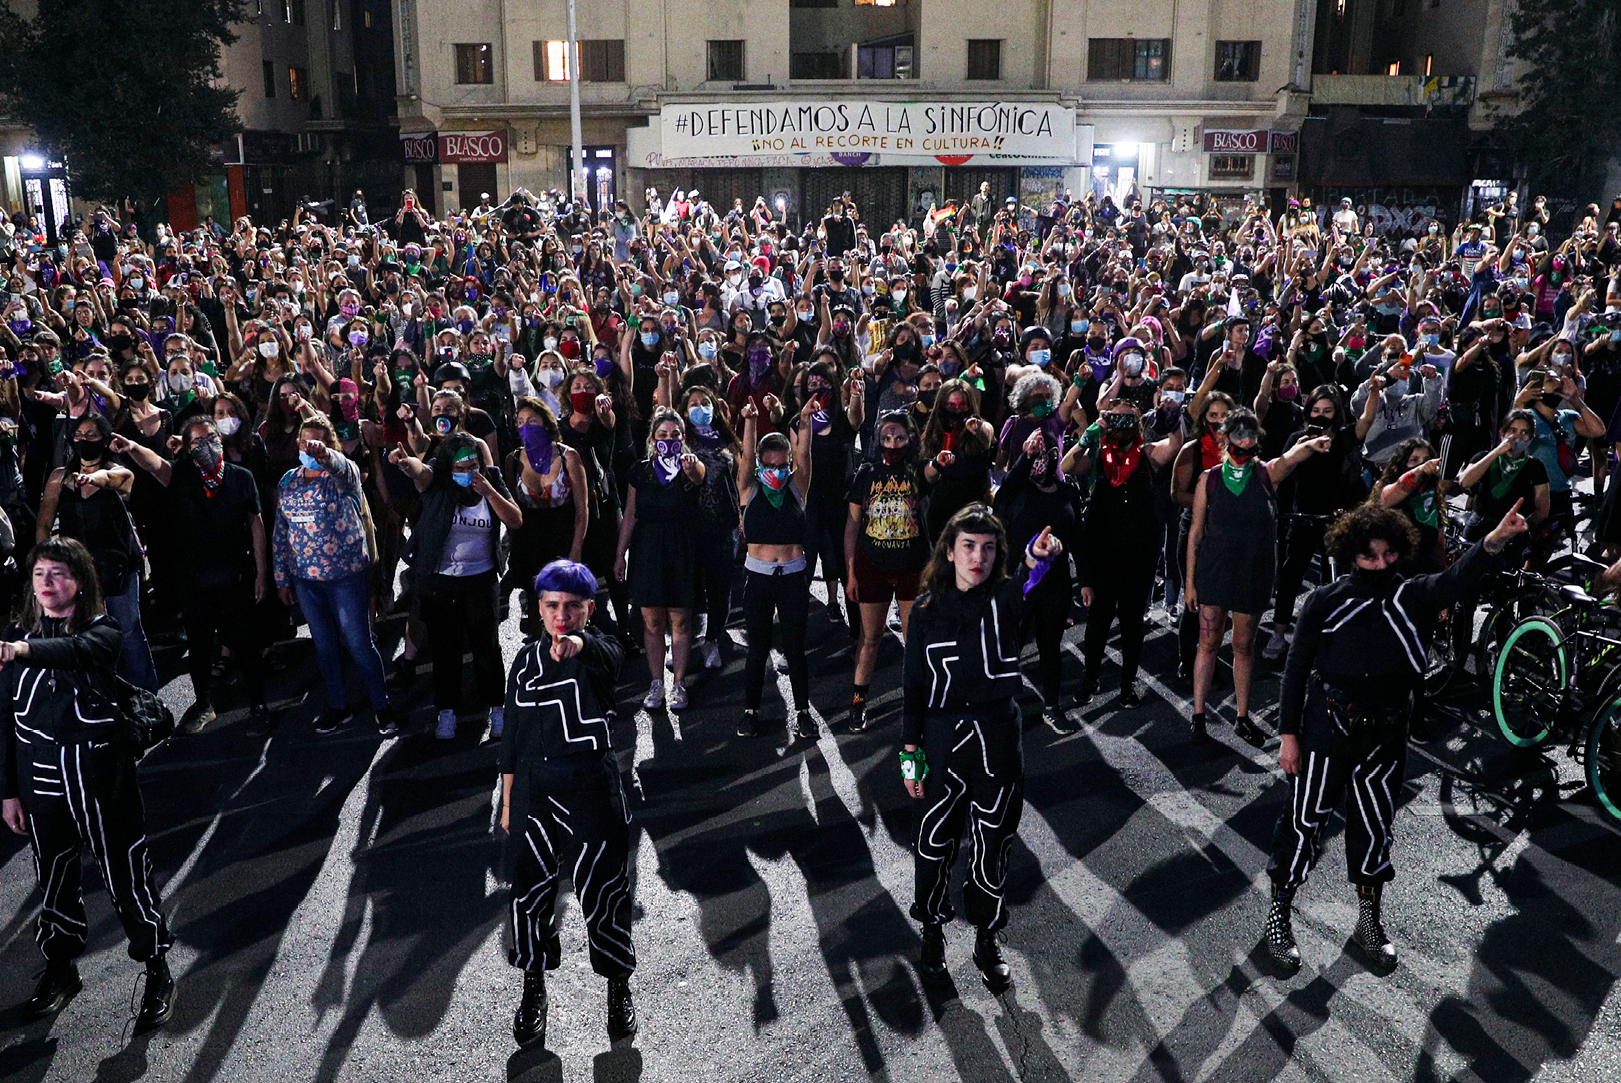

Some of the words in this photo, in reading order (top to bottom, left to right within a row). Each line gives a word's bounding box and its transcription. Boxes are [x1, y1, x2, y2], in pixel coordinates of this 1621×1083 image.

[675, 104, 850, 137] #DEFENDAMOS
[857, 103, 875, 132] A
[886, 107, 912, 134] LA
[404, 139, 435, 159] BLASCO
[446, 136, 503, 157] BLASCO
[791, 137, 807, 149] AL
[816, 134, 888, 148] RECORTE
[896, 138, 913, 149] EN
[922, 135, 1005, 151] CULTURA!!
[1213, 133, 1257, 149] BLASCO
